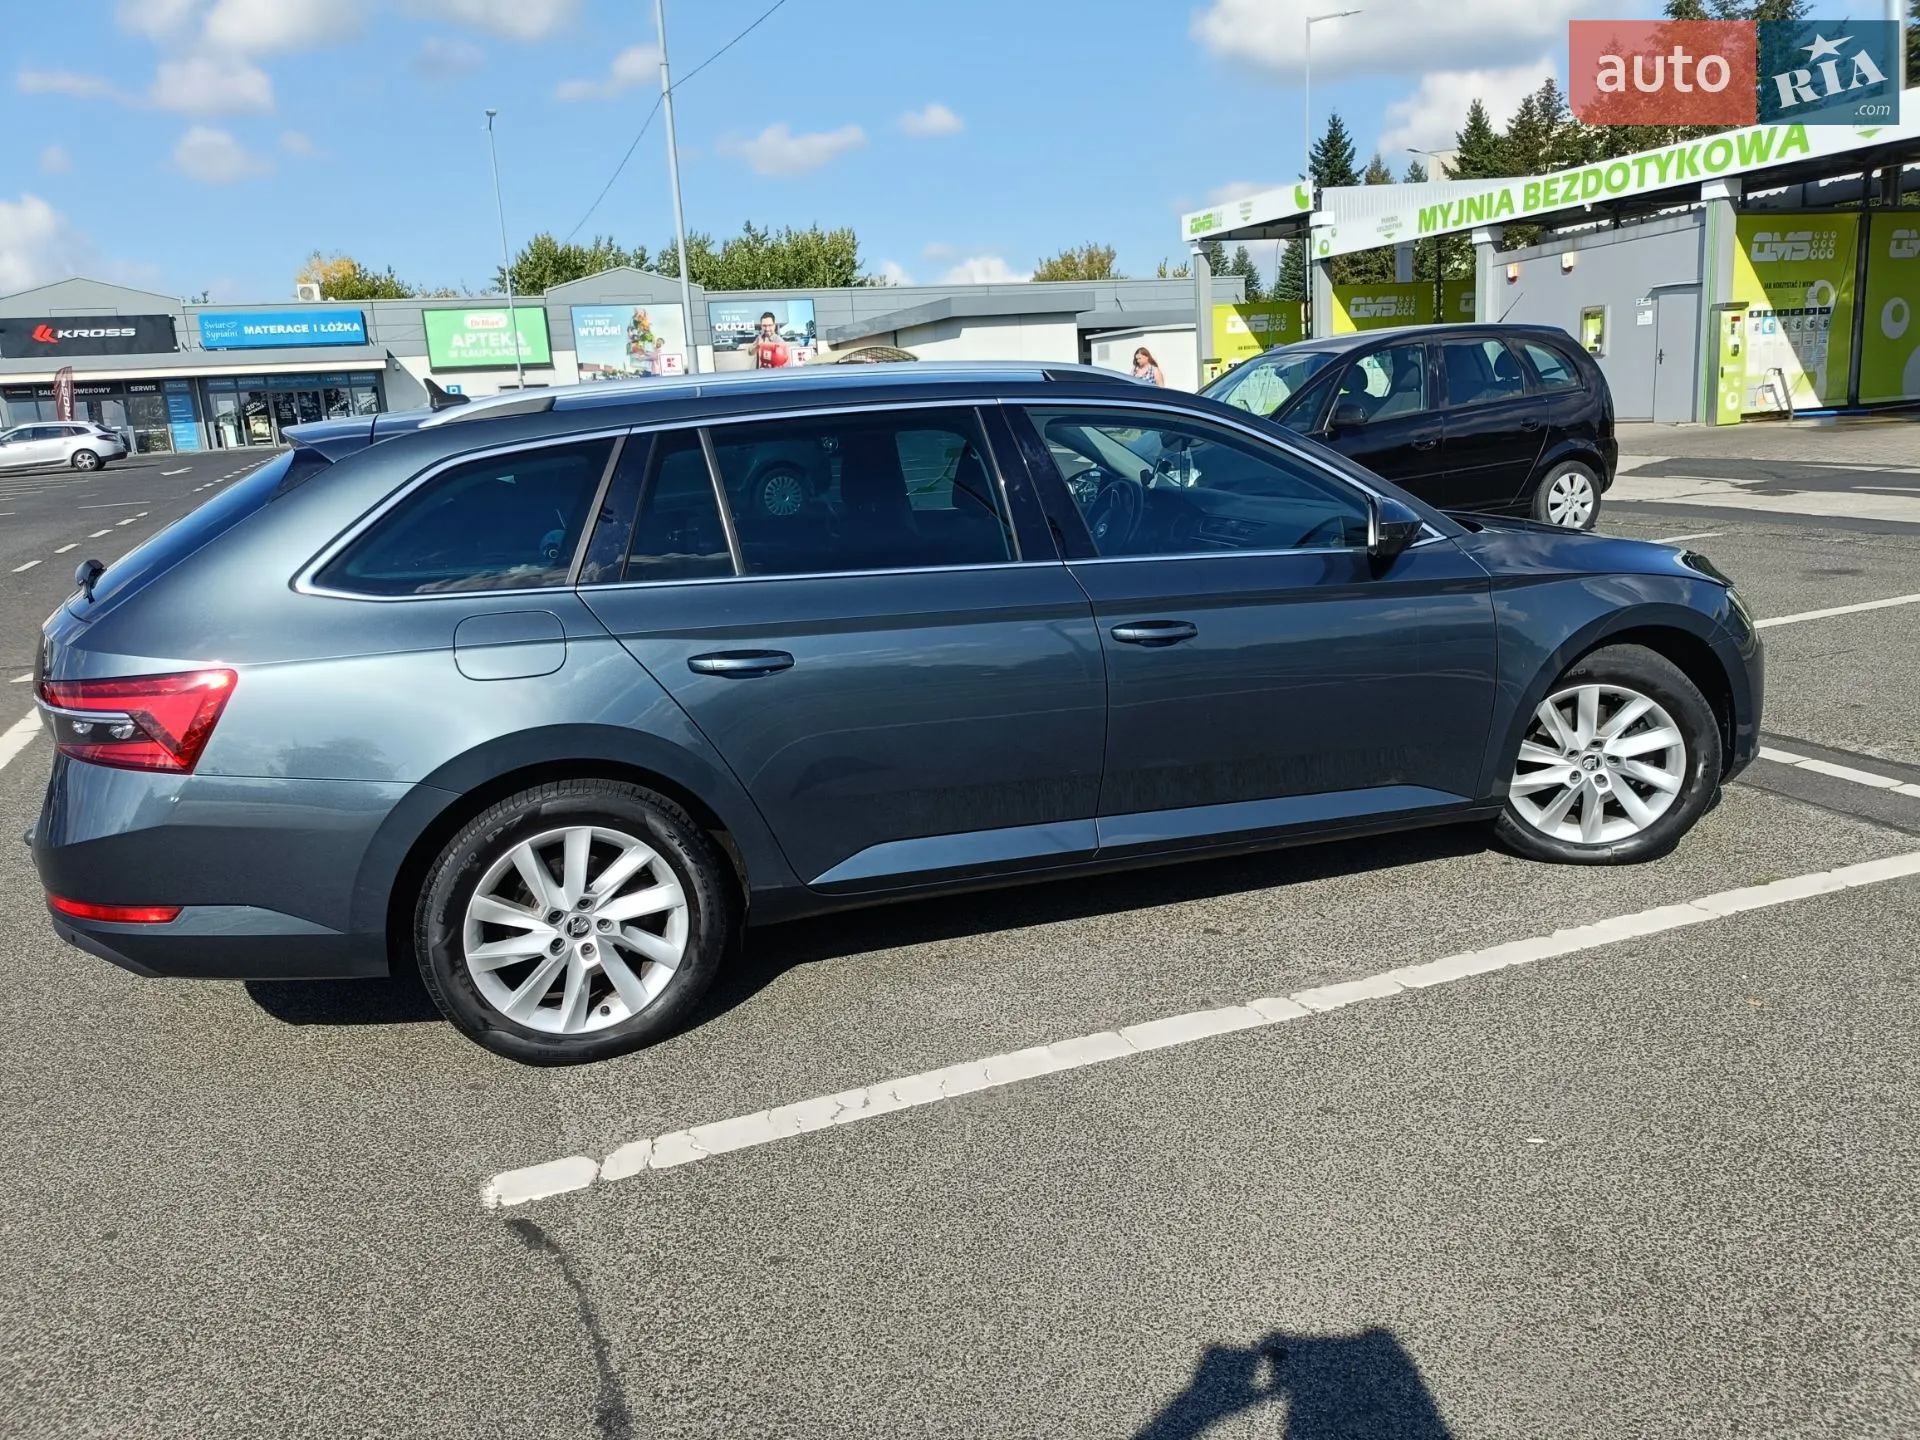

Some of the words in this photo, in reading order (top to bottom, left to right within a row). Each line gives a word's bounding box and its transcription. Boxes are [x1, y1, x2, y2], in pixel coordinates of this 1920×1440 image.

[1418, 188, 1515, 234] MYJNIA
[1522, 121, 1811, 213] BEZDOTYKOWA
[204, 319, 226, 329] Świat
[244, 324, 309, 335] MATERACE
[313, 323, 318, 333] I
[319, 321, 361, 333] ŁÓŻKA
[579, 324, 621, 337] WYBÓR!
[715, 319, 755, 332] OKAZJE!
[57, 327, 136, 339] KROSS
[206, 328, 238, 342] Sypialni
[451, 330, 527, 348] APTEKA
[72, 387, 111, 395] OWEROWY
[130, 384, 157, 392] SERWIS
